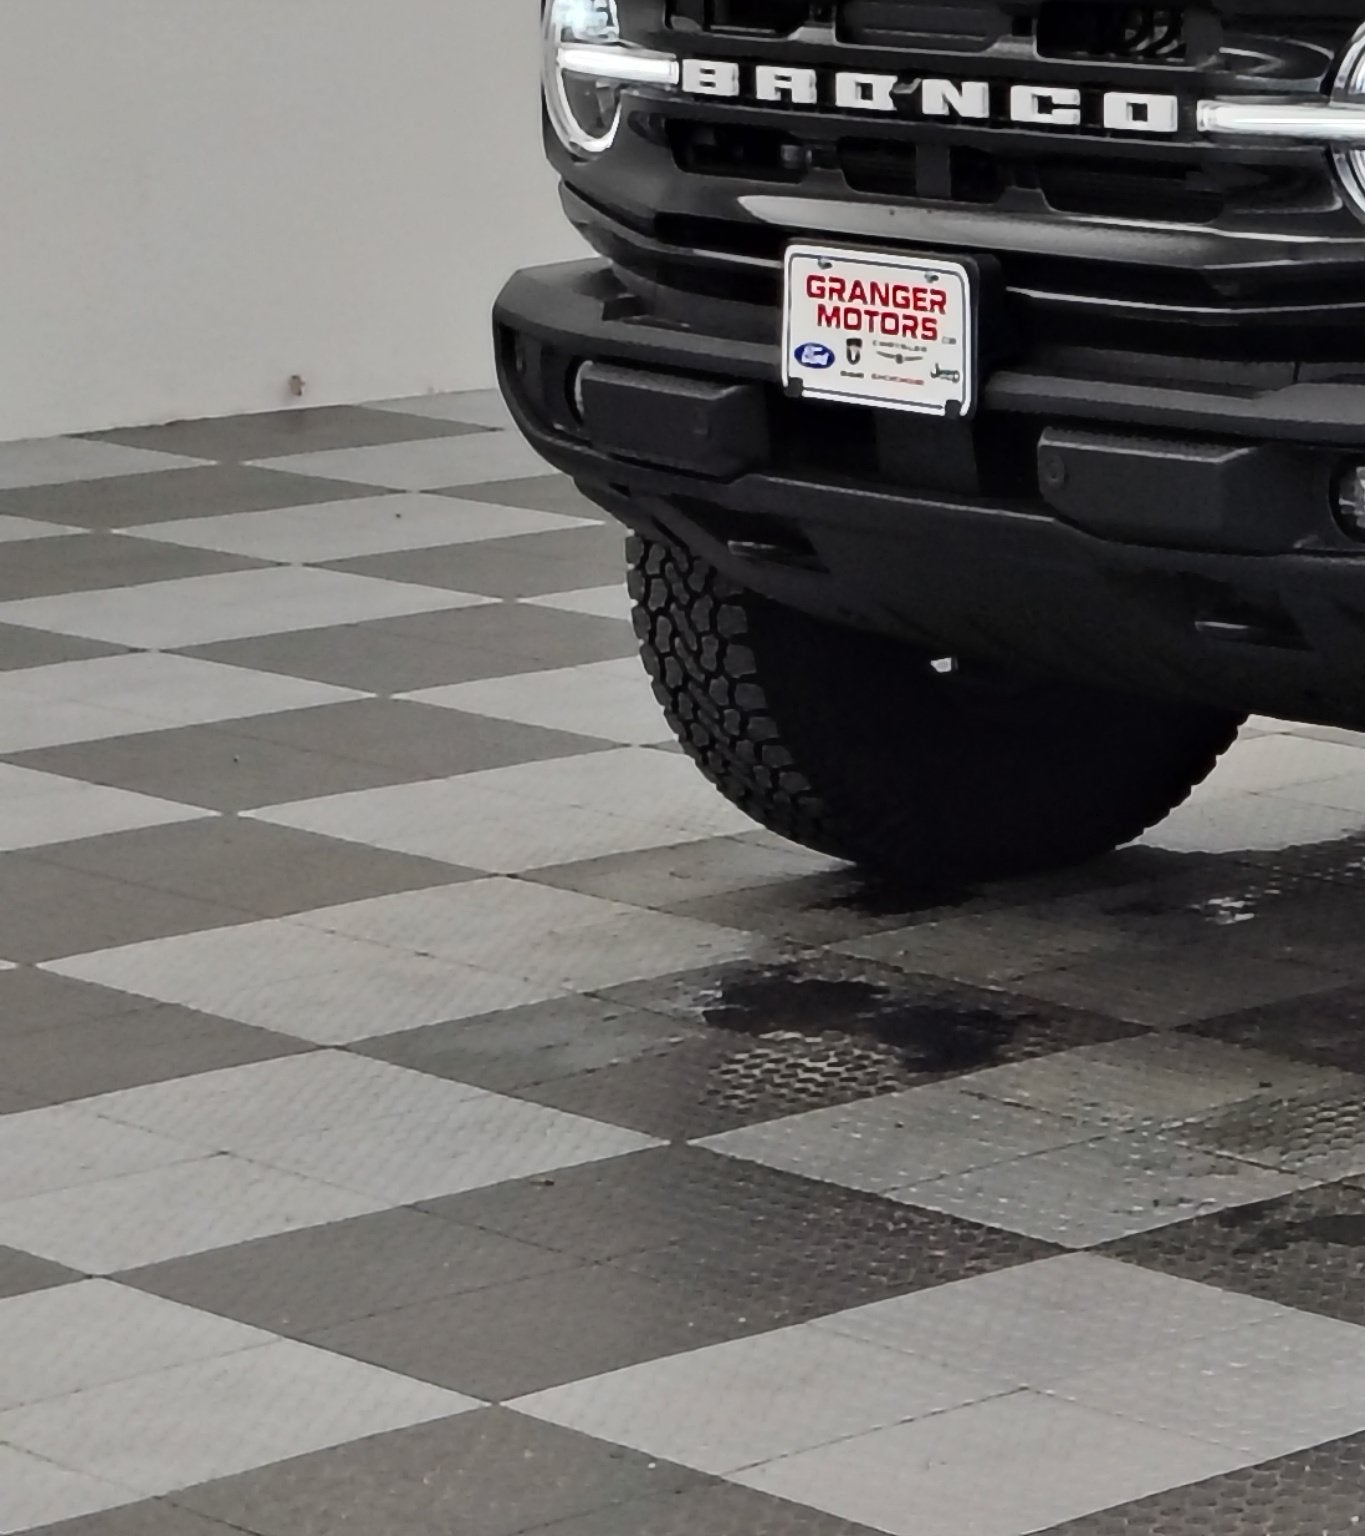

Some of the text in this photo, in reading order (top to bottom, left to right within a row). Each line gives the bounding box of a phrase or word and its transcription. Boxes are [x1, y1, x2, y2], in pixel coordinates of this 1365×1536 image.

[682, 59, 1179, 132] BRONCO
[806, 274, 948, 315] GRANGER
[817, 304, 938, 341] MOTORS
